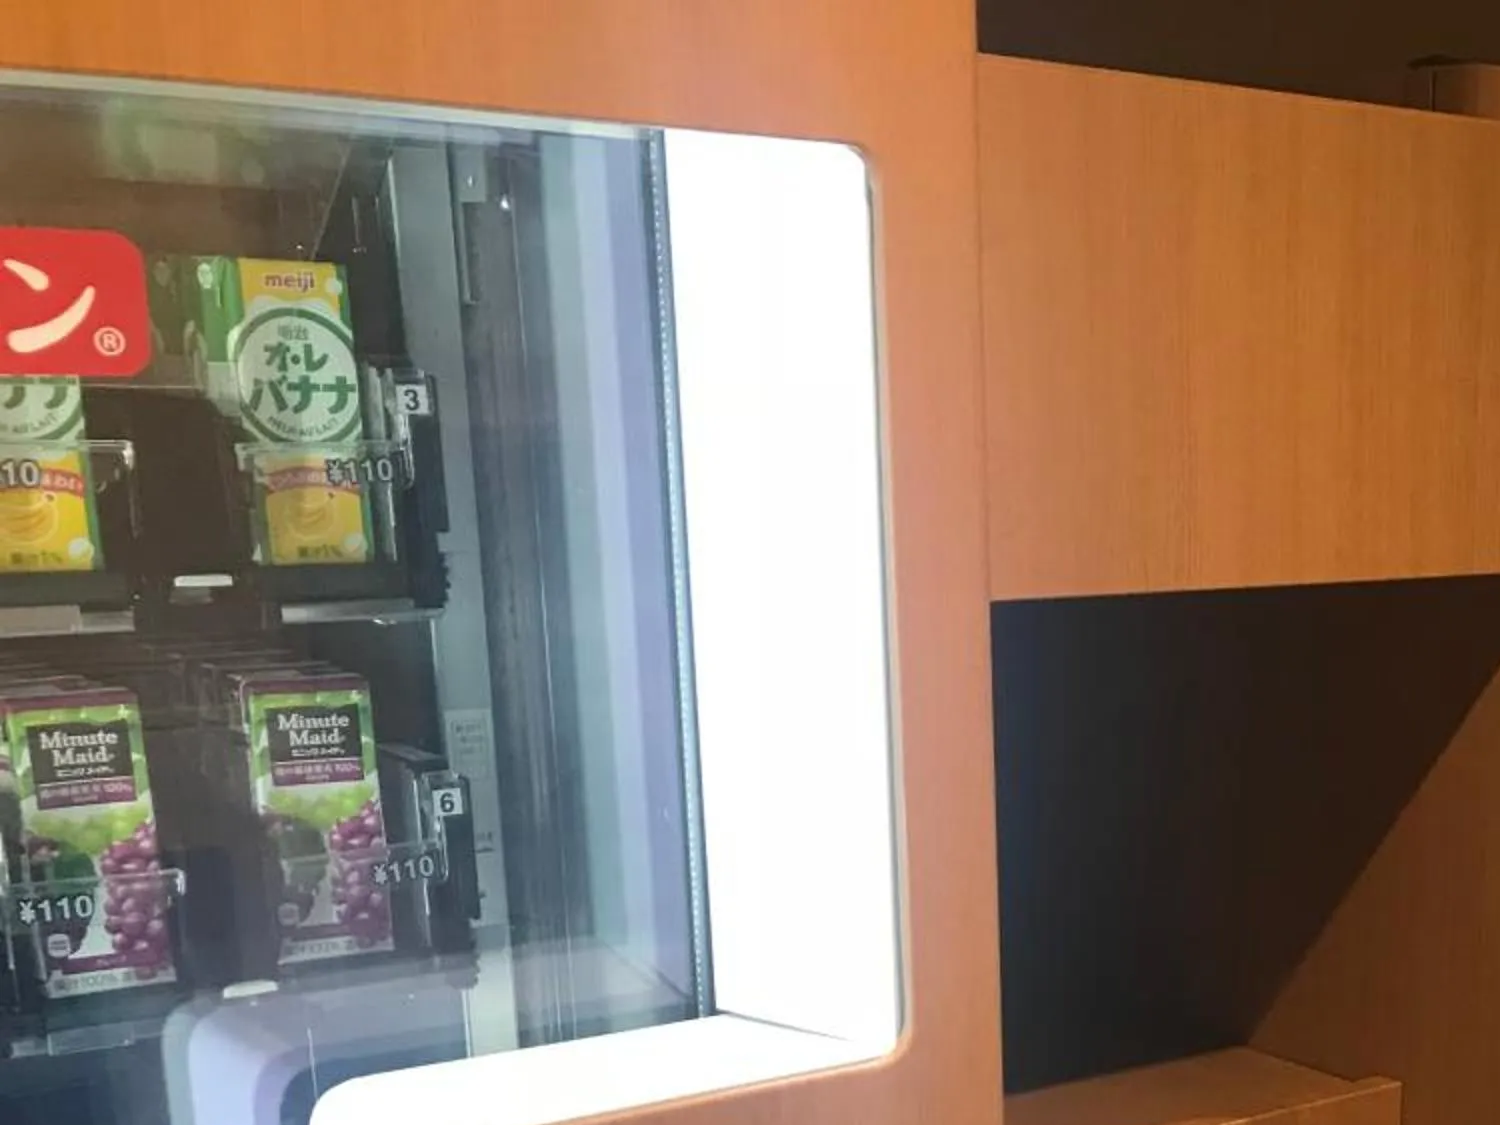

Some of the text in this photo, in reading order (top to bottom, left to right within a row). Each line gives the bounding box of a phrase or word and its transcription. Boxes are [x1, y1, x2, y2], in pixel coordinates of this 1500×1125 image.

[265, 272, 315, 293] meiji
[250, 374, 357, 415] バナナ
[403, 388, 420, 411] 3
[0, 460, 40, 487] 10
[326, 458, 394, 485] ¥110
[277, 712, 350, 731] Minute
[39, 731, 119, 750] Minute
[288, 728, 343, 746] Maid
[52, 746, 110, 767] Maid
[440, 791, 455, 813] 6
[373, 855, 435, 885] ¥110
[20, 895, 93, 924] ¥110
